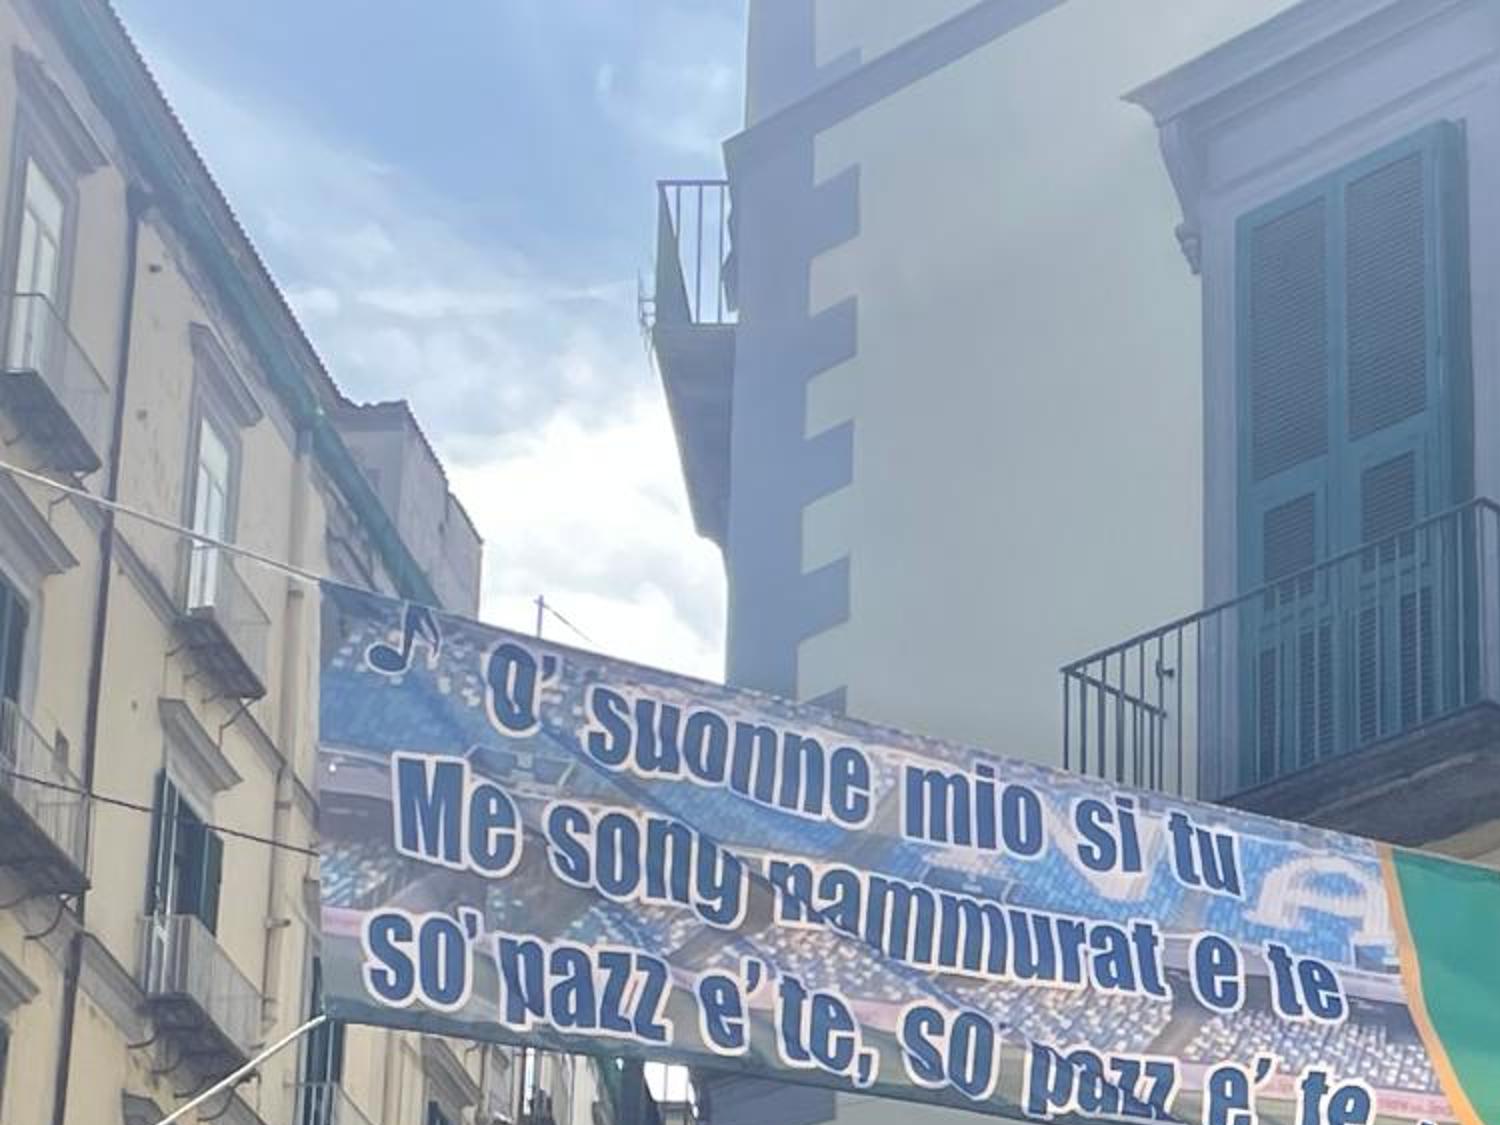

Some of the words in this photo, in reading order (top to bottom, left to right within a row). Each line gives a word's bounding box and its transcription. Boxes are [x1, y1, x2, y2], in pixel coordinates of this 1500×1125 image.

[396, 756, 521, 875] Me
[547, 805, 746, 928] song
[769, 859, 1167, 998] nammurat
[1195, 934, 1241, 1010] e
[1266, 941, 1346, 1021] te
[586, 686, 873, 828] suonne
[905, 763, 1044, 856] mio
[1074, 796, 1143, 873] si
[1169, 811, 1241, 896] tu
[502, 935, 671, 1043] pazz
[1027, 1042, 1184, 1122] pazz
